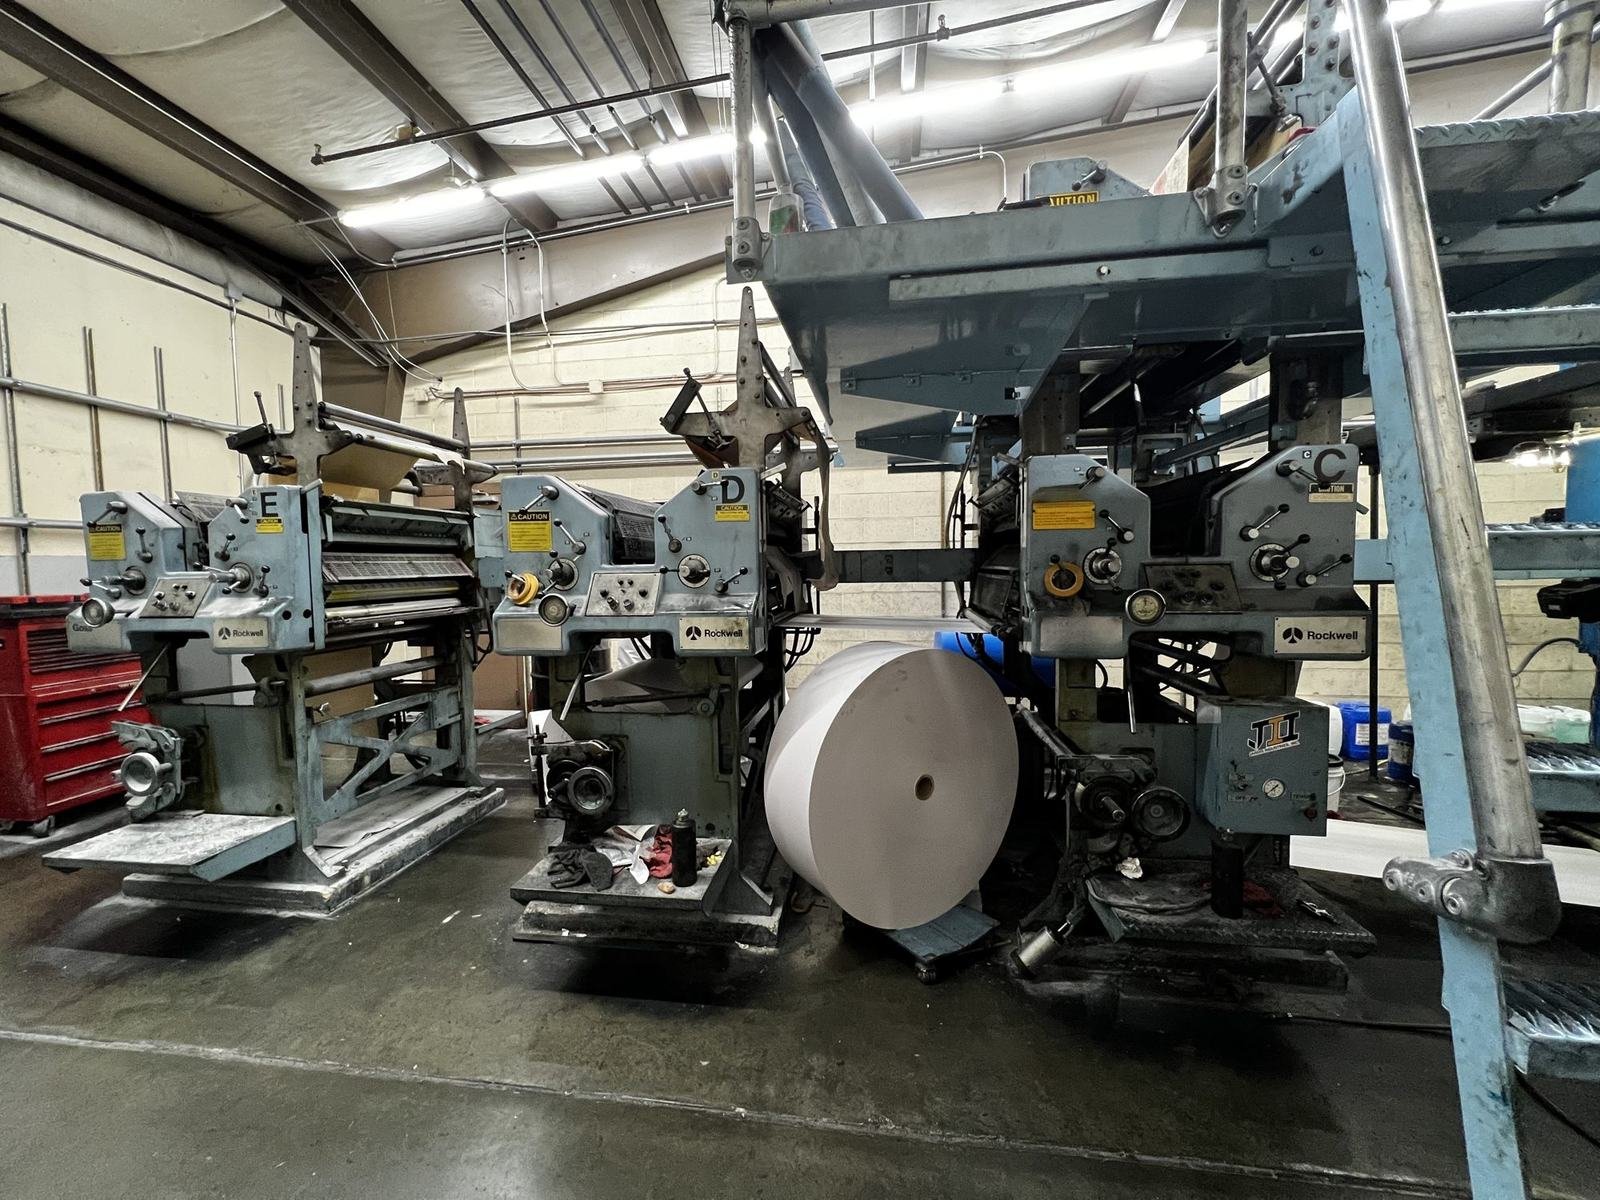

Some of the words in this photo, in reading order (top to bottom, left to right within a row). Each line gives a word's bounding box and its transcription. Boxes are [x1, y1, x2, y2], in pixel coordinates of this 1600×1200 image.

[1303, 451, 1311, 459] C
[1313, 448, 1347, 483] C
[721, 475, 745, 504] D
[260, 491, 279, 517] E
[232, 629, 264, 637] Rockwell
[704, 628, 743, 638] Rockwell
[1307, 630, 1358, 640] Rockwell
